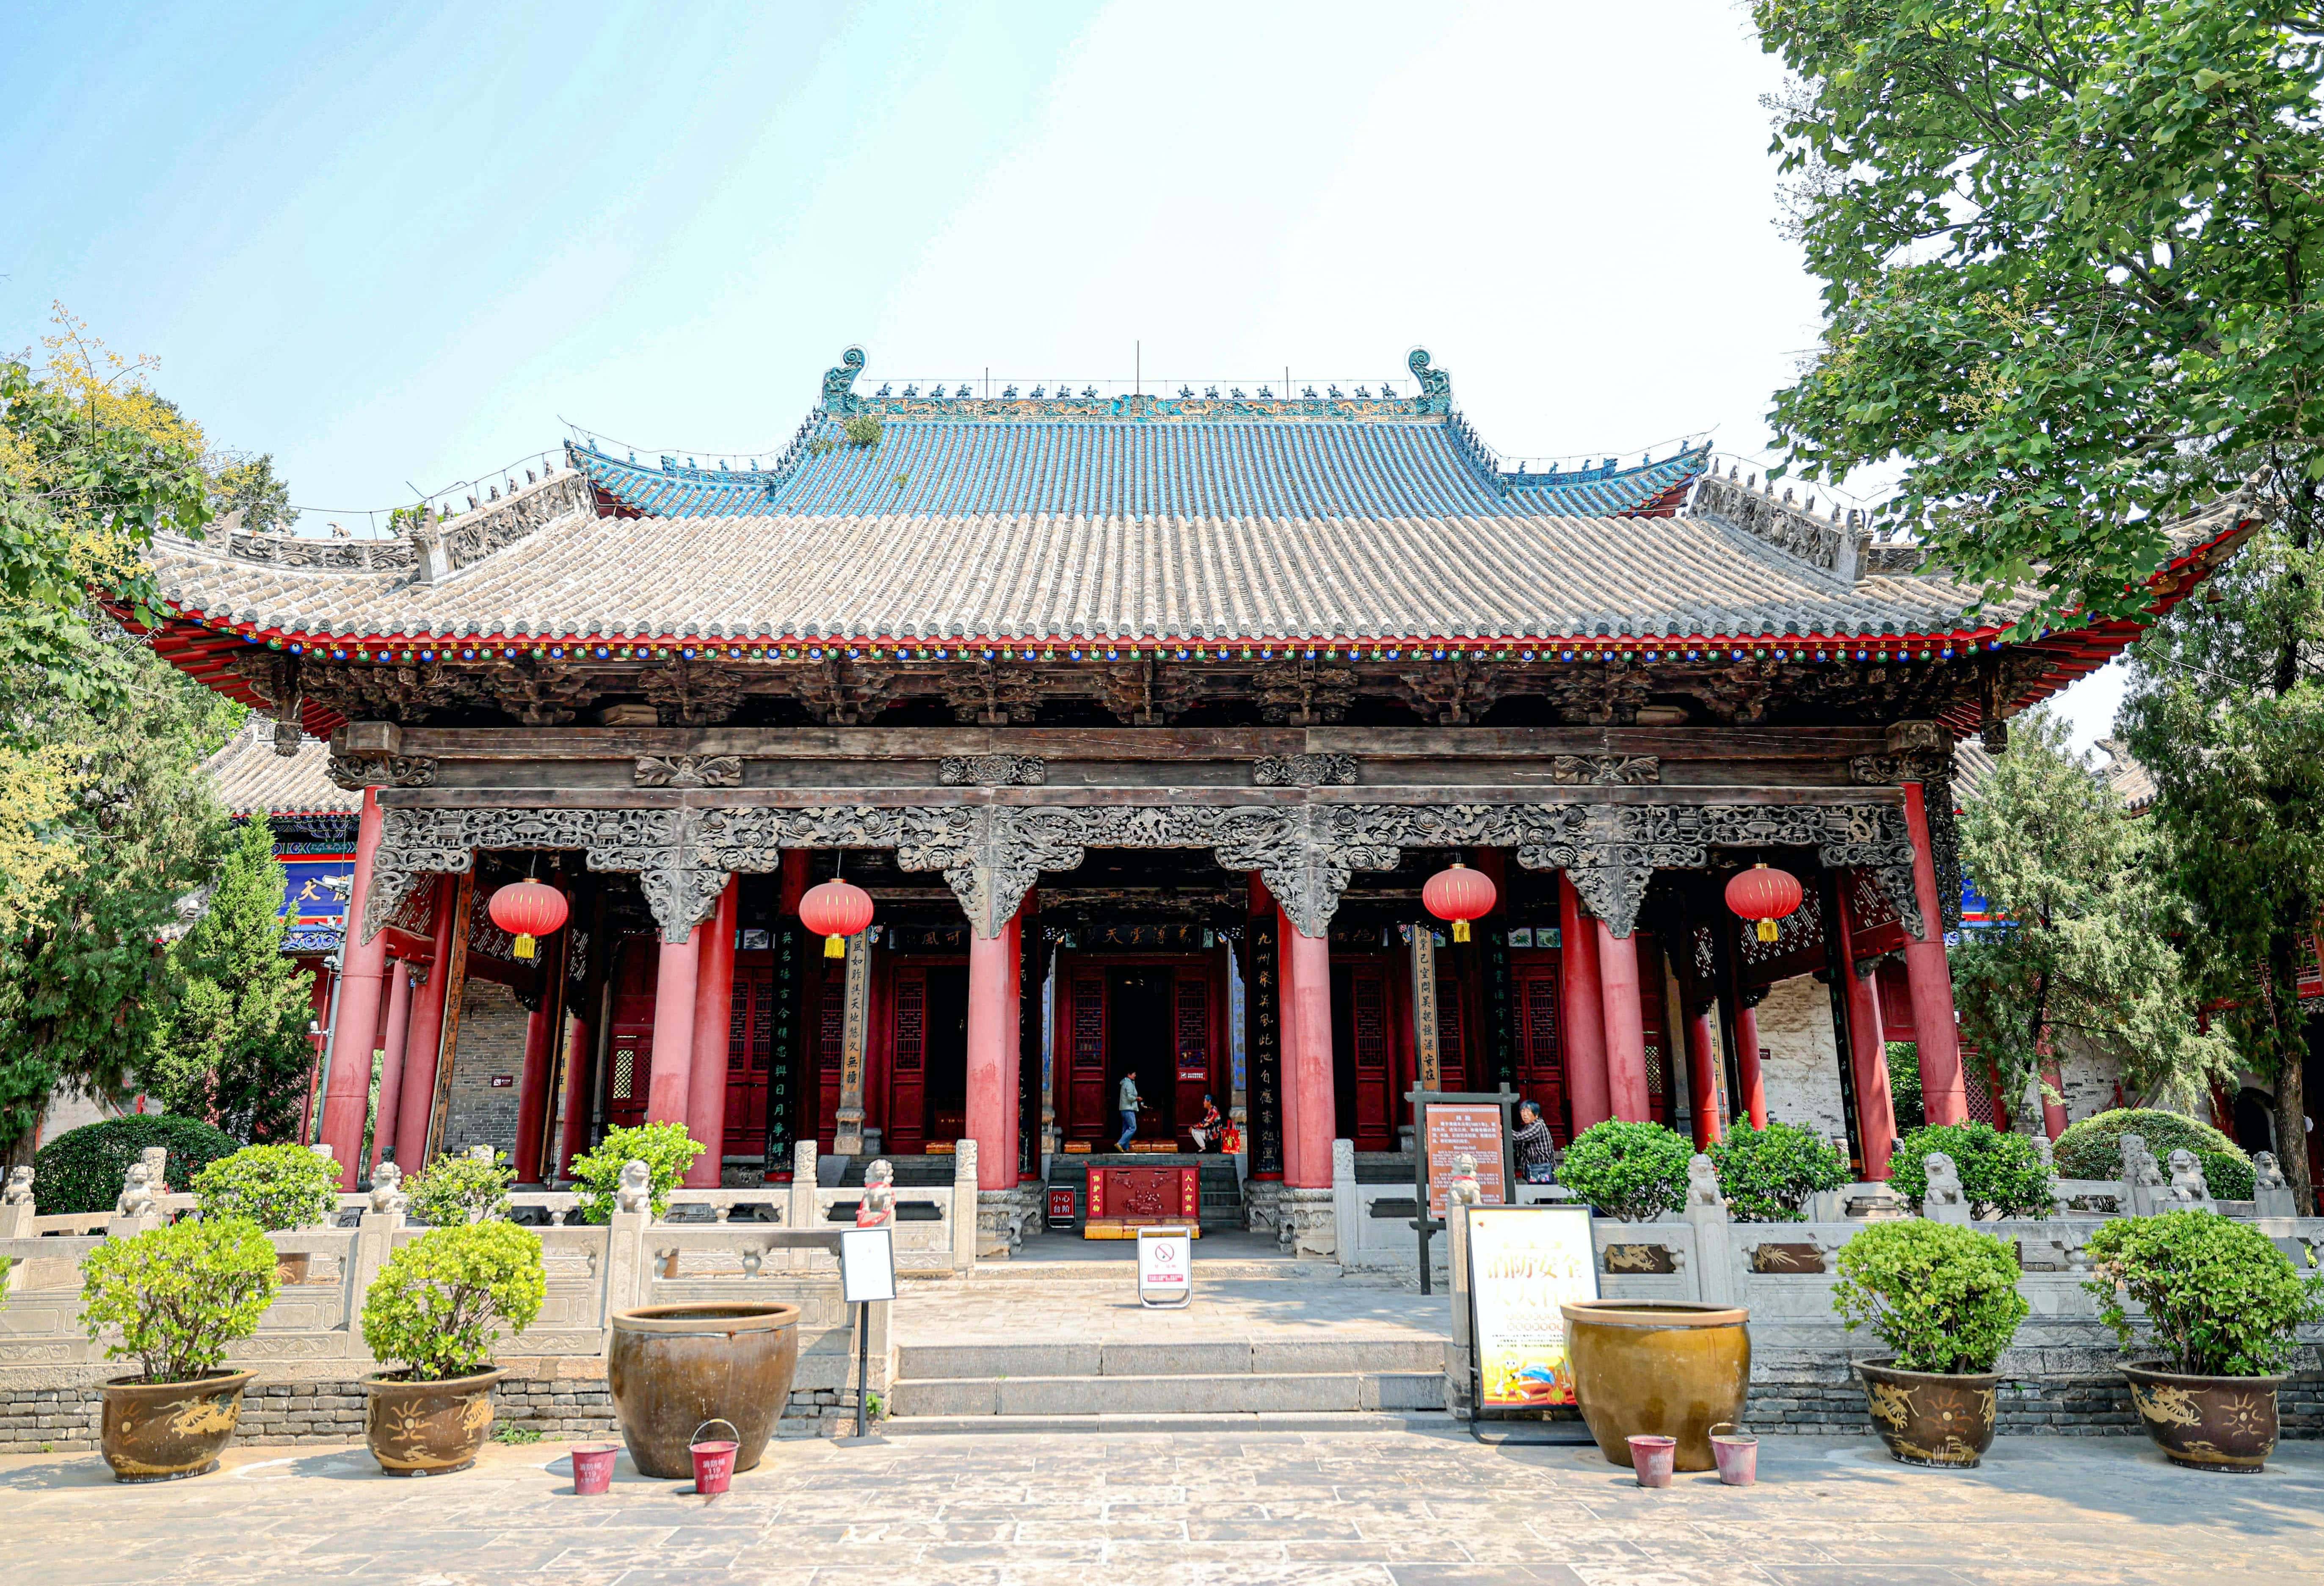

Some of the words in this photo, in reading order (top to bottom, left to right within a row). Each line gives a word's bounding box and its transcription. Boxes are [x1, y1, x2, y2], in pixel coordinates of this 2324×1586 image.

[1053, 1194, 1070, 1203] 小心
[1093, 1175, 1101, 1213] 保护文物
[1054, 1205, 1070, 1213] 台阶
